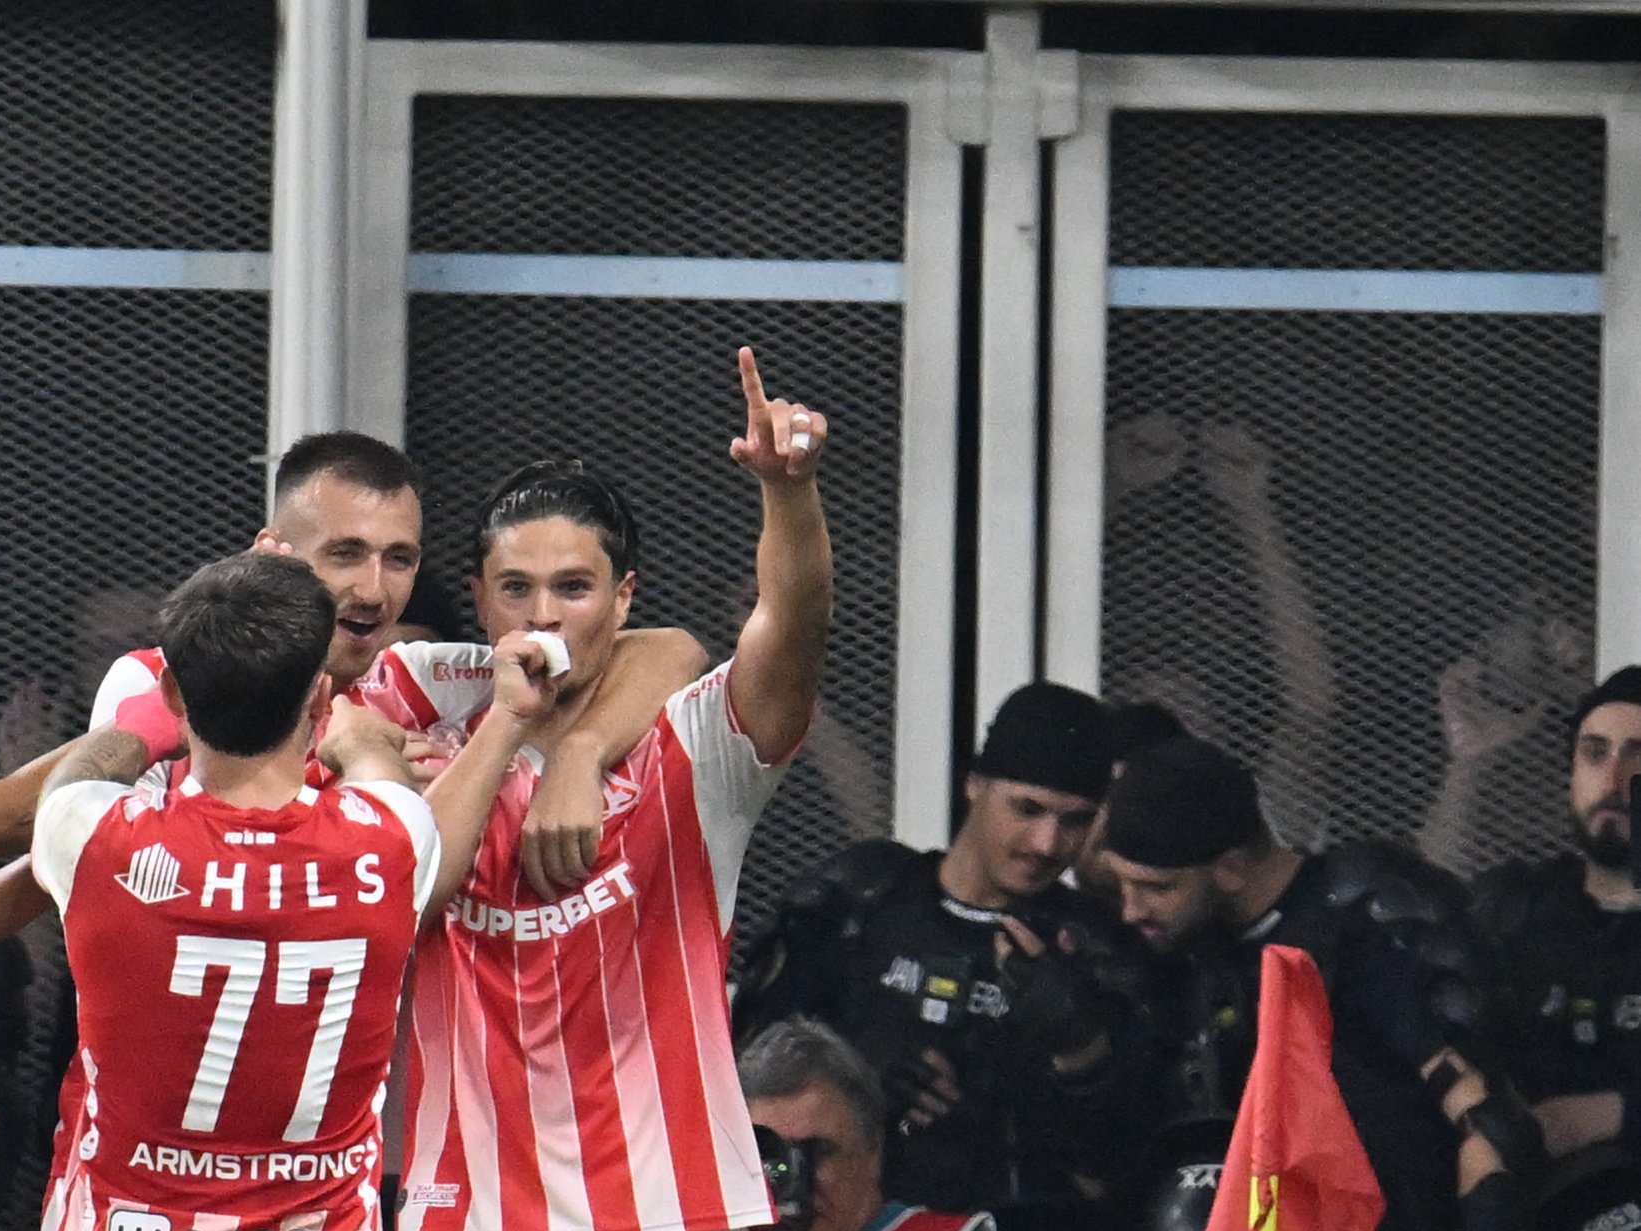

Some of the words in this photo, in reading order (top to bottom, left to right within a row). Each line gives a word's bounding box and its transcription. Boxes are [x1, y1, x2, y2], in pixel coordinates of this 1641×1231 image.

[199, 854, 386, 911] HILS
[169, 936, 367, 1142] 77
[129, 1143, 366, 1181] ARMSTRONG
